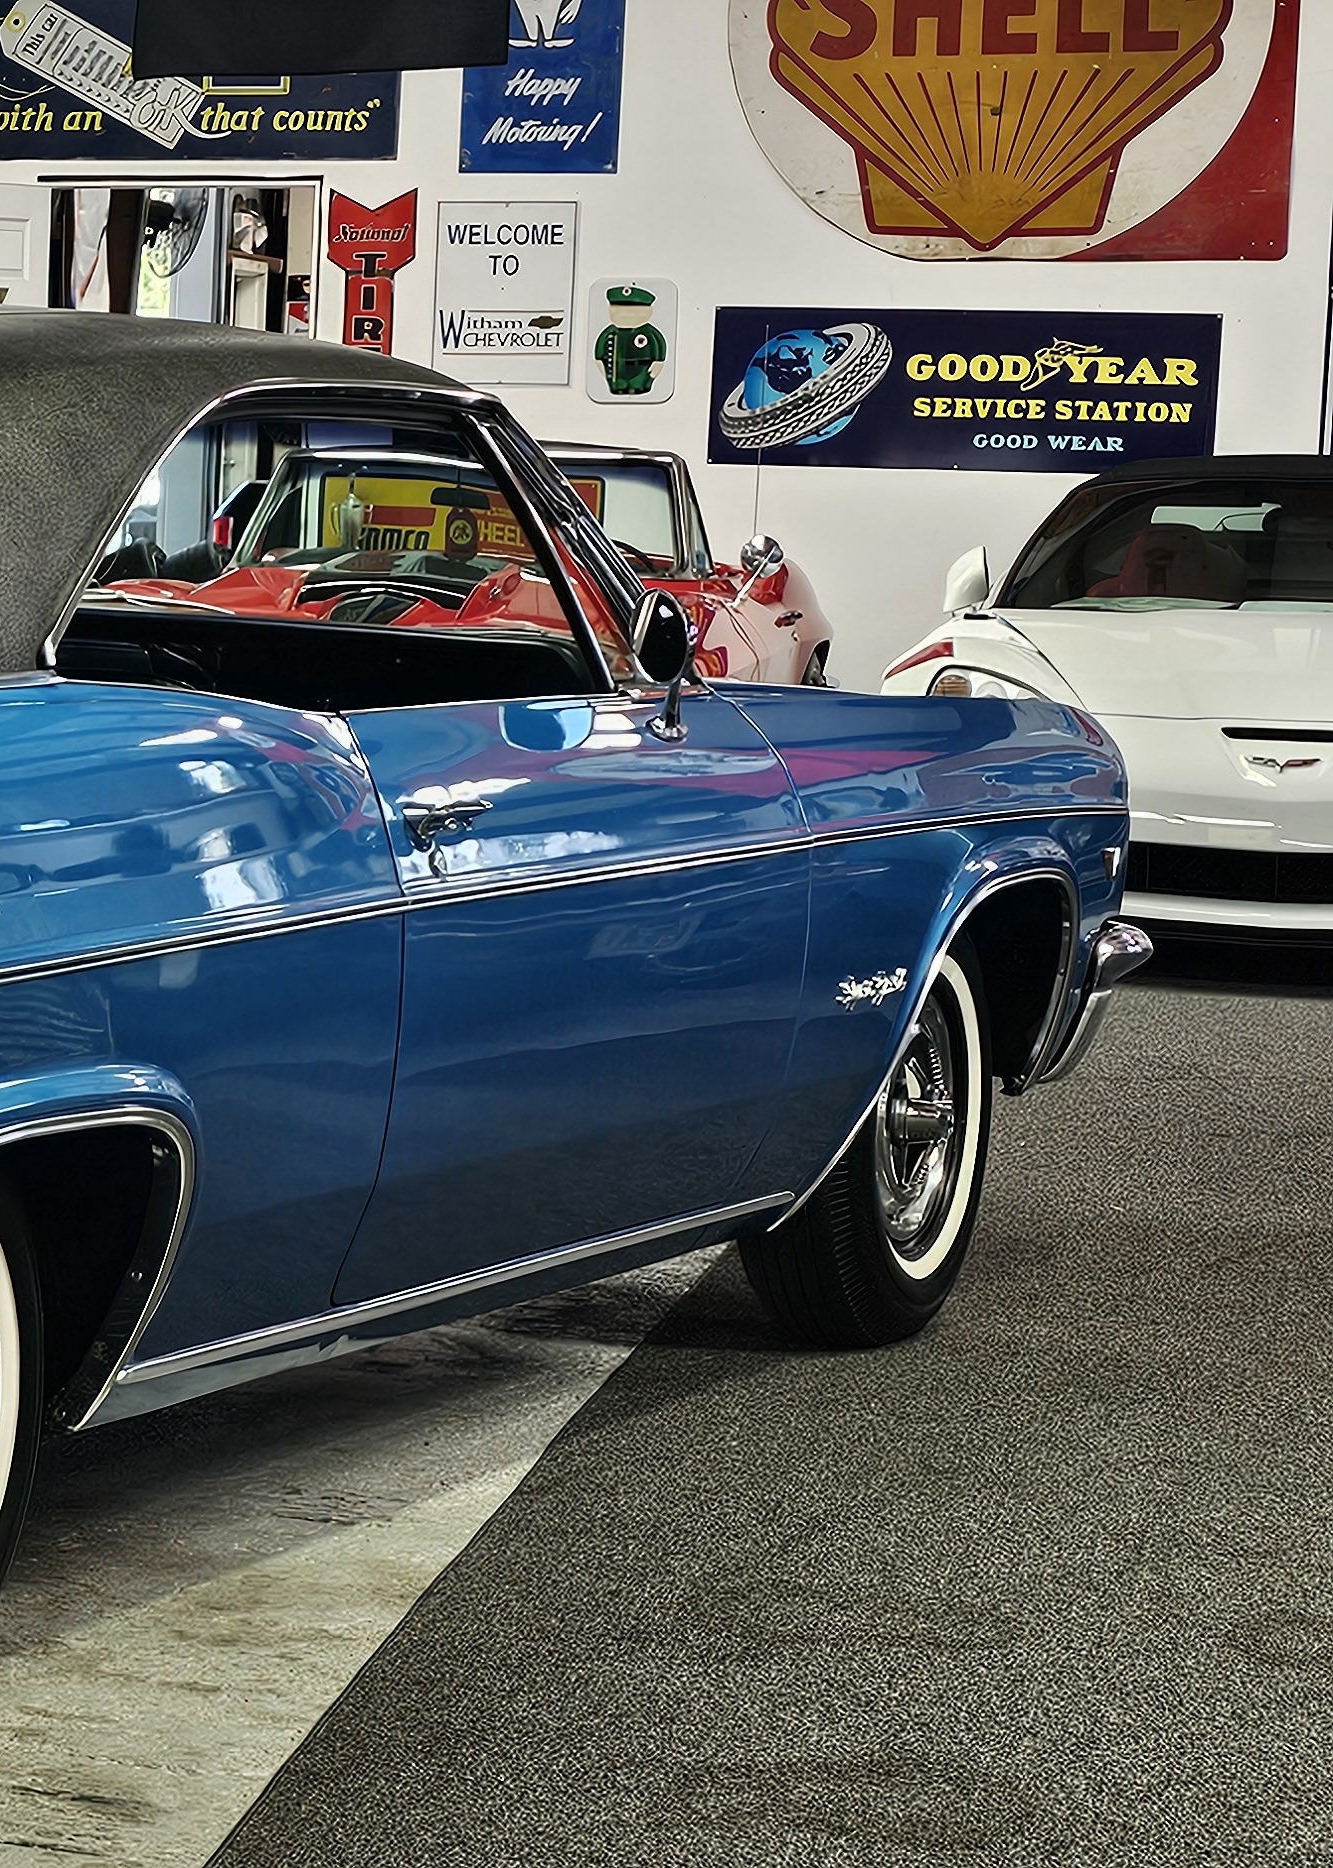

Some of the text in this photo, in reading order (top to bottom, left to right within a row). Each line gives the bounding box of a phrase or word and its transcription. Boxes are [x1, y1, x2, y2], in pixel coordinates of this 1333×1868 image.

[504, 67, 582, 106] Happy
[63, 110, 102, 131] an
[201, 102, 263, 131] that
[482, 111, 602, 151] Motoring!
[447, 224, 564, 244] WELCOME
[488, 255, 520, 276] TO
[353, 252, 386, 352] TIR
[439, 309, 523, 349] Witham
[463, 332, 564, 347] CHEVROLET
[912, 397, 1192, 424] SERVICE STATION
[972, 433, 1124, 453] GOOD WEAR
